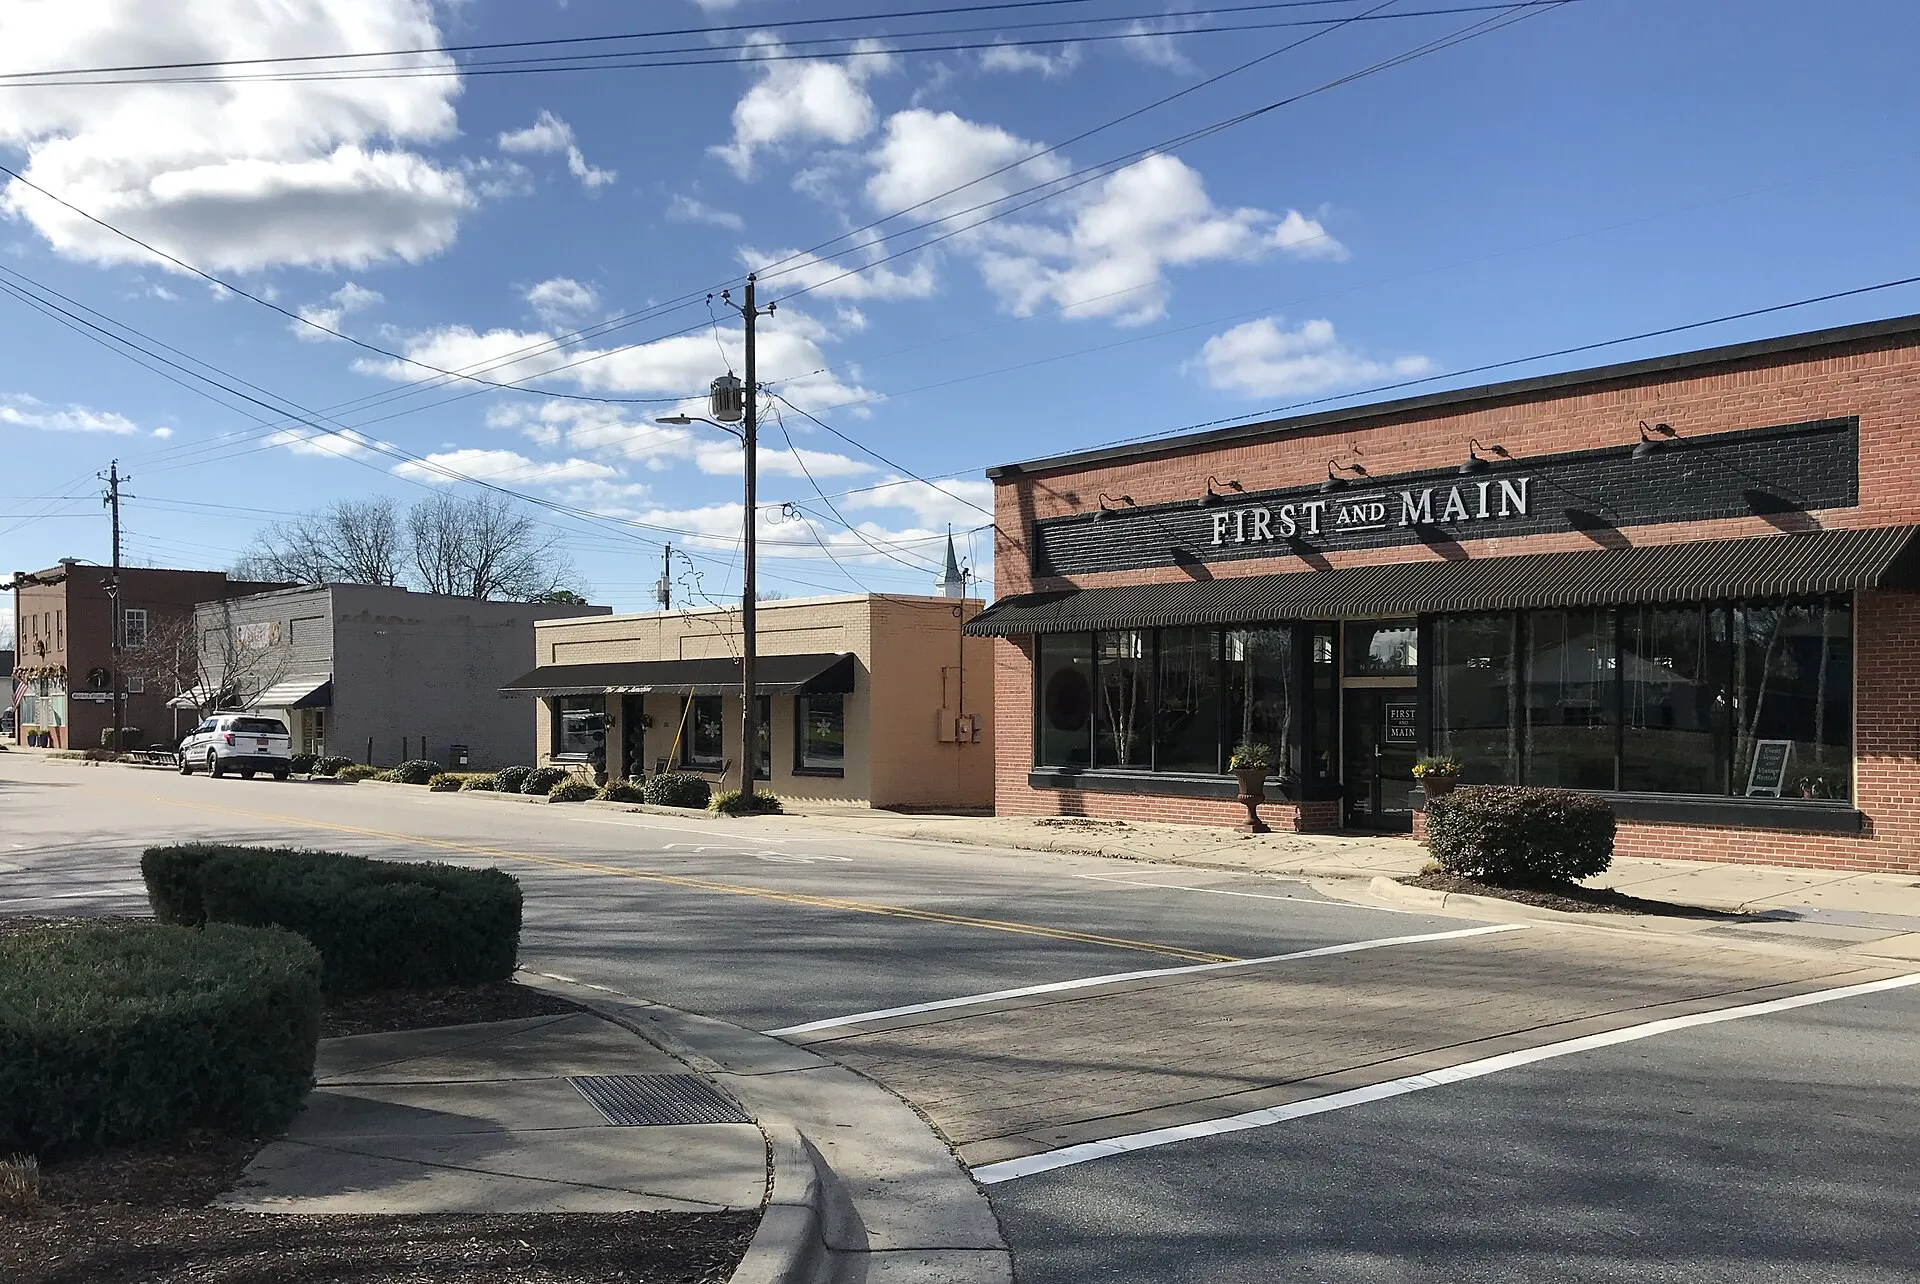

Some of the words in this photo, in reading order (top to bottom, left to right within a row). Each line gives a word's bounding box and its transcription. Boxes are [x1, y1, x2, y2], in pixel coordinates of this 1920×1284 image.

[1211, 500, 1327, 545] FIRST
[1336, 503, 1385, 524] AND
[1399, 477, 1530, 526] MAIN
[1391, 709, 1416, 718] FIRST
[1391, 728, 1415, 737] MAIN
